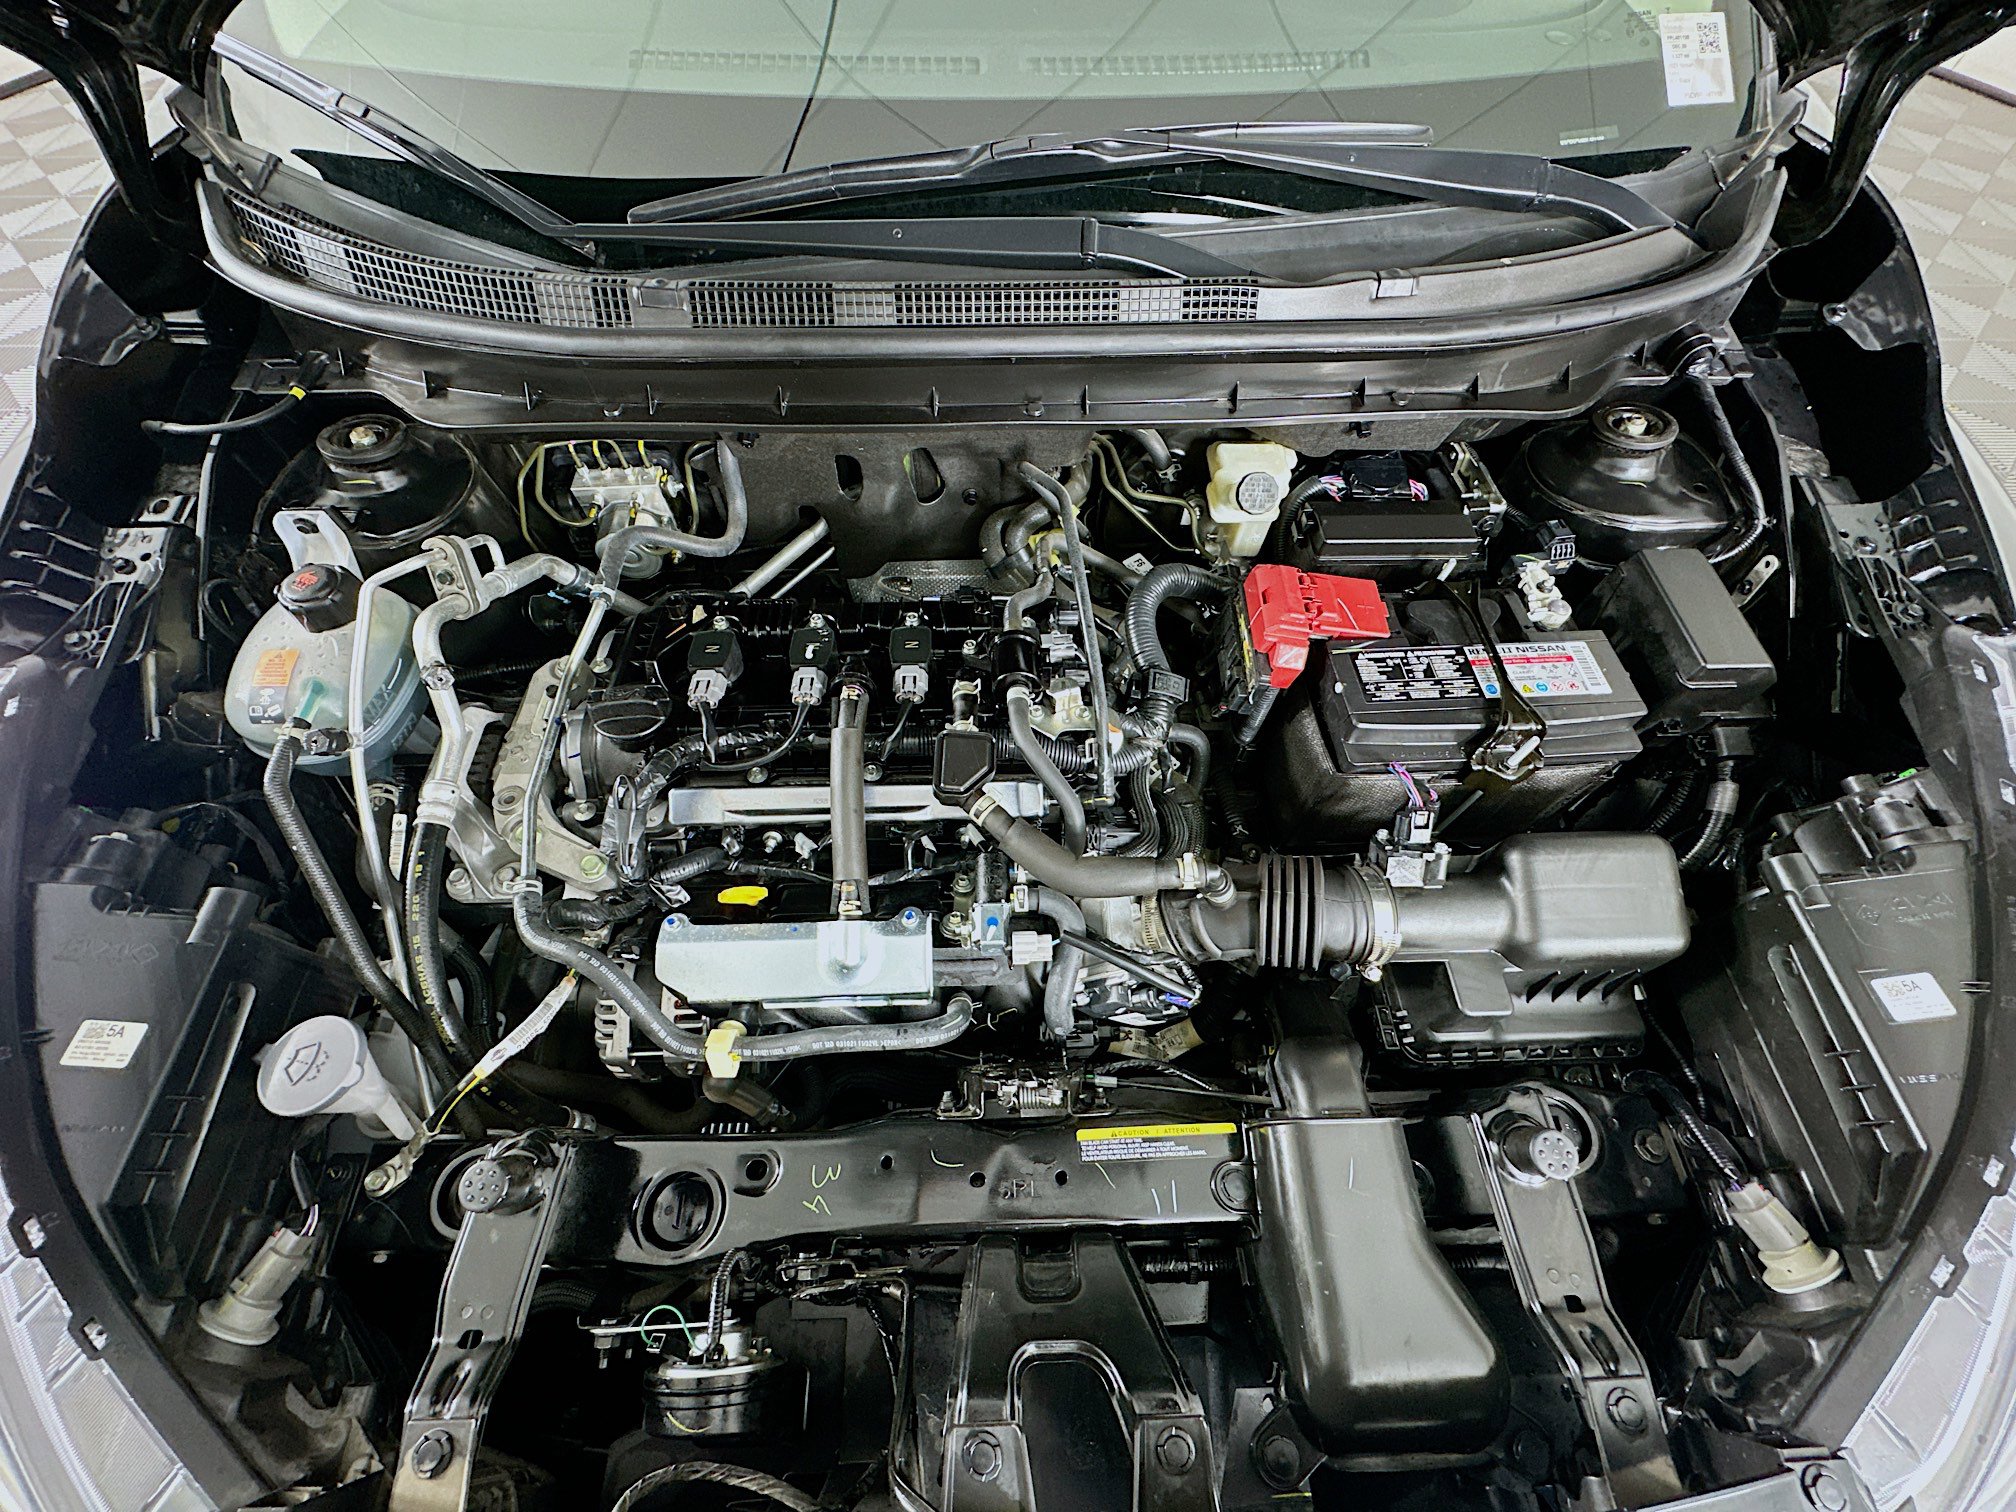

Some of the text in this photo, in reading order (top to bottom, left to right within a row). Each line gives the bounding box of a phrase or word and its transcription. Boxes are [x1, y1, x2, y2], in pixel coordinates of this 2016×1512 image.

[1516, 644, 1567, 654] NISSAN
[1901, 980, 1922, 992] 5A
[106, 1024, 126, 1038] 5A
[812, 1040, 823, 1049] DOT
[835, 1040, 857, 1048] 031021
[1117, 1129, 1149, 1137] CAUTION
